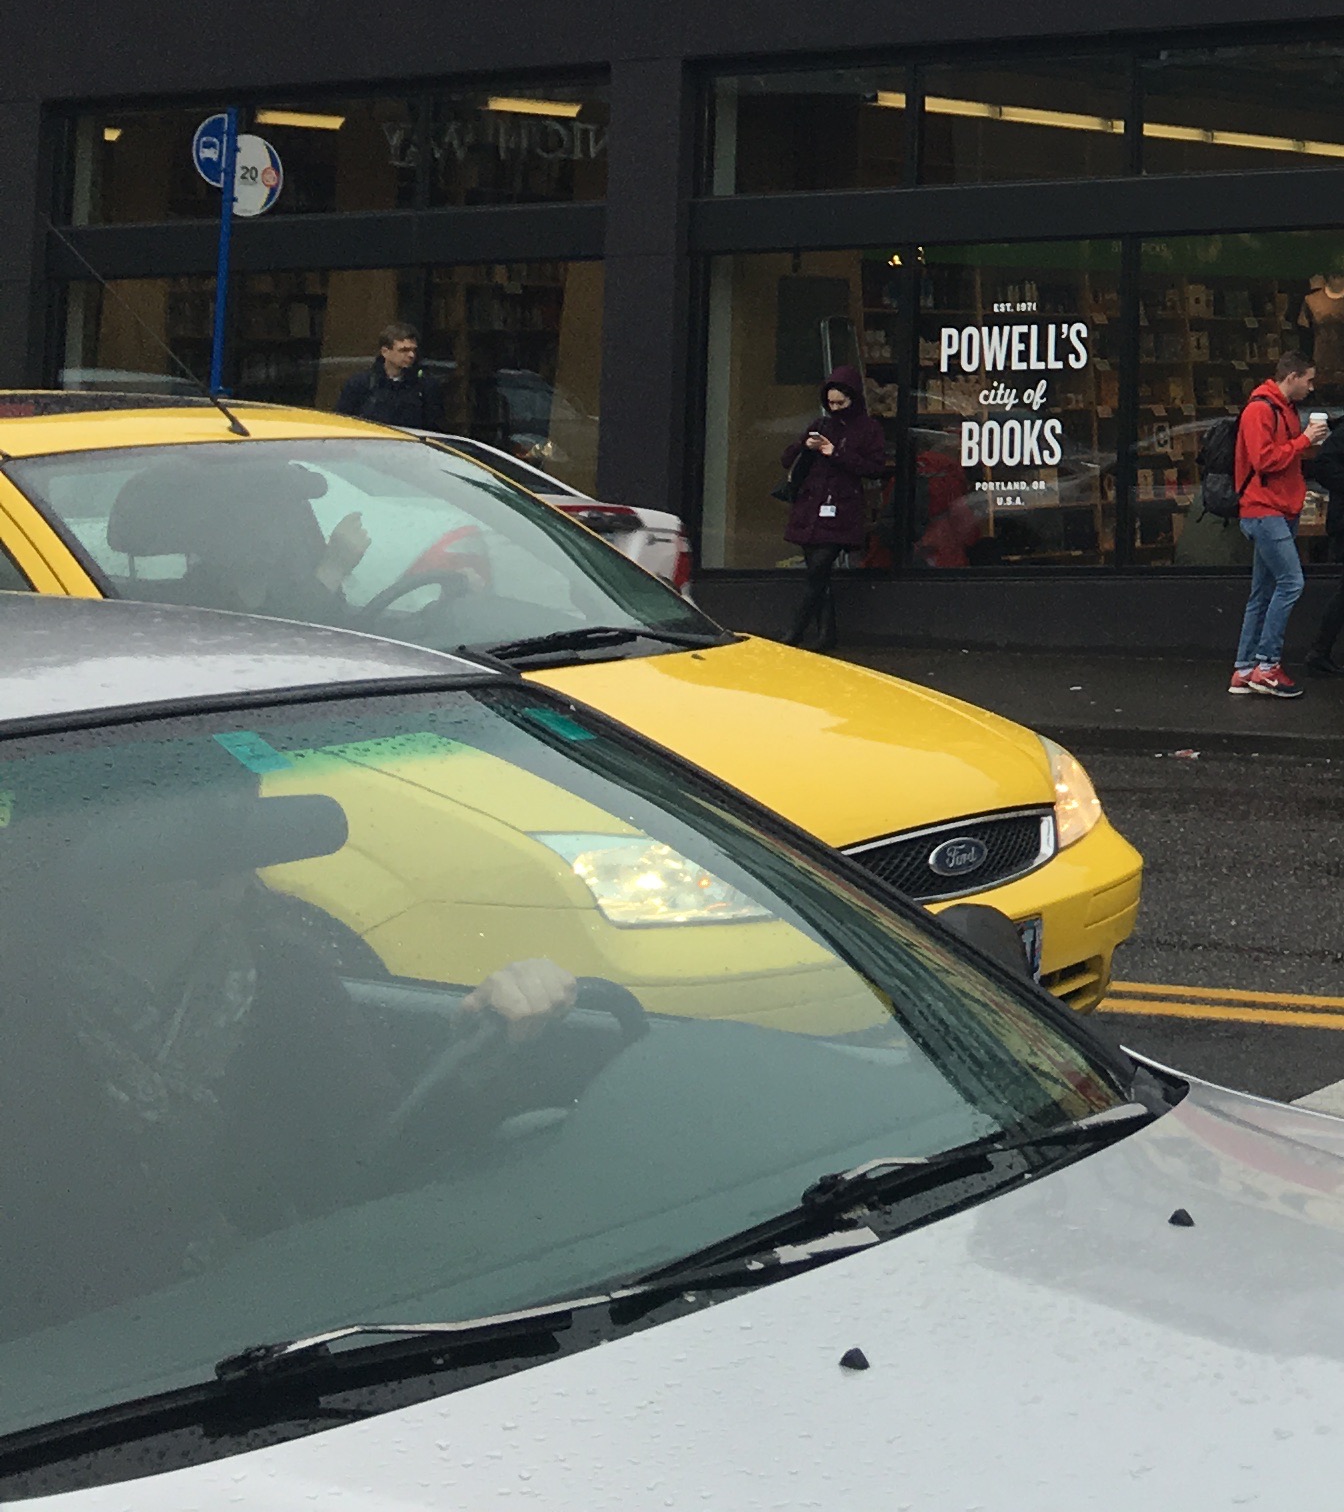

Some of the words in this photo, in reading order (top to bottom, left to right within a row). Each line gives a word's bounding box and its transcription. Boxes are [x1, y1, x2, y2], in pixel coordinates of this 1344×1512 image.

[239, 165, 259, 181] 20
[939, 321, 1089, 373] POWELL'S
[978, 380, 1019, 412] city
[1022, 379, 1047, 411] of
[960, 418, 1063, 468] BOOKS
[996, 496, 1025, 506] U.S.A.
[945, 843, 977, 868] Ford
